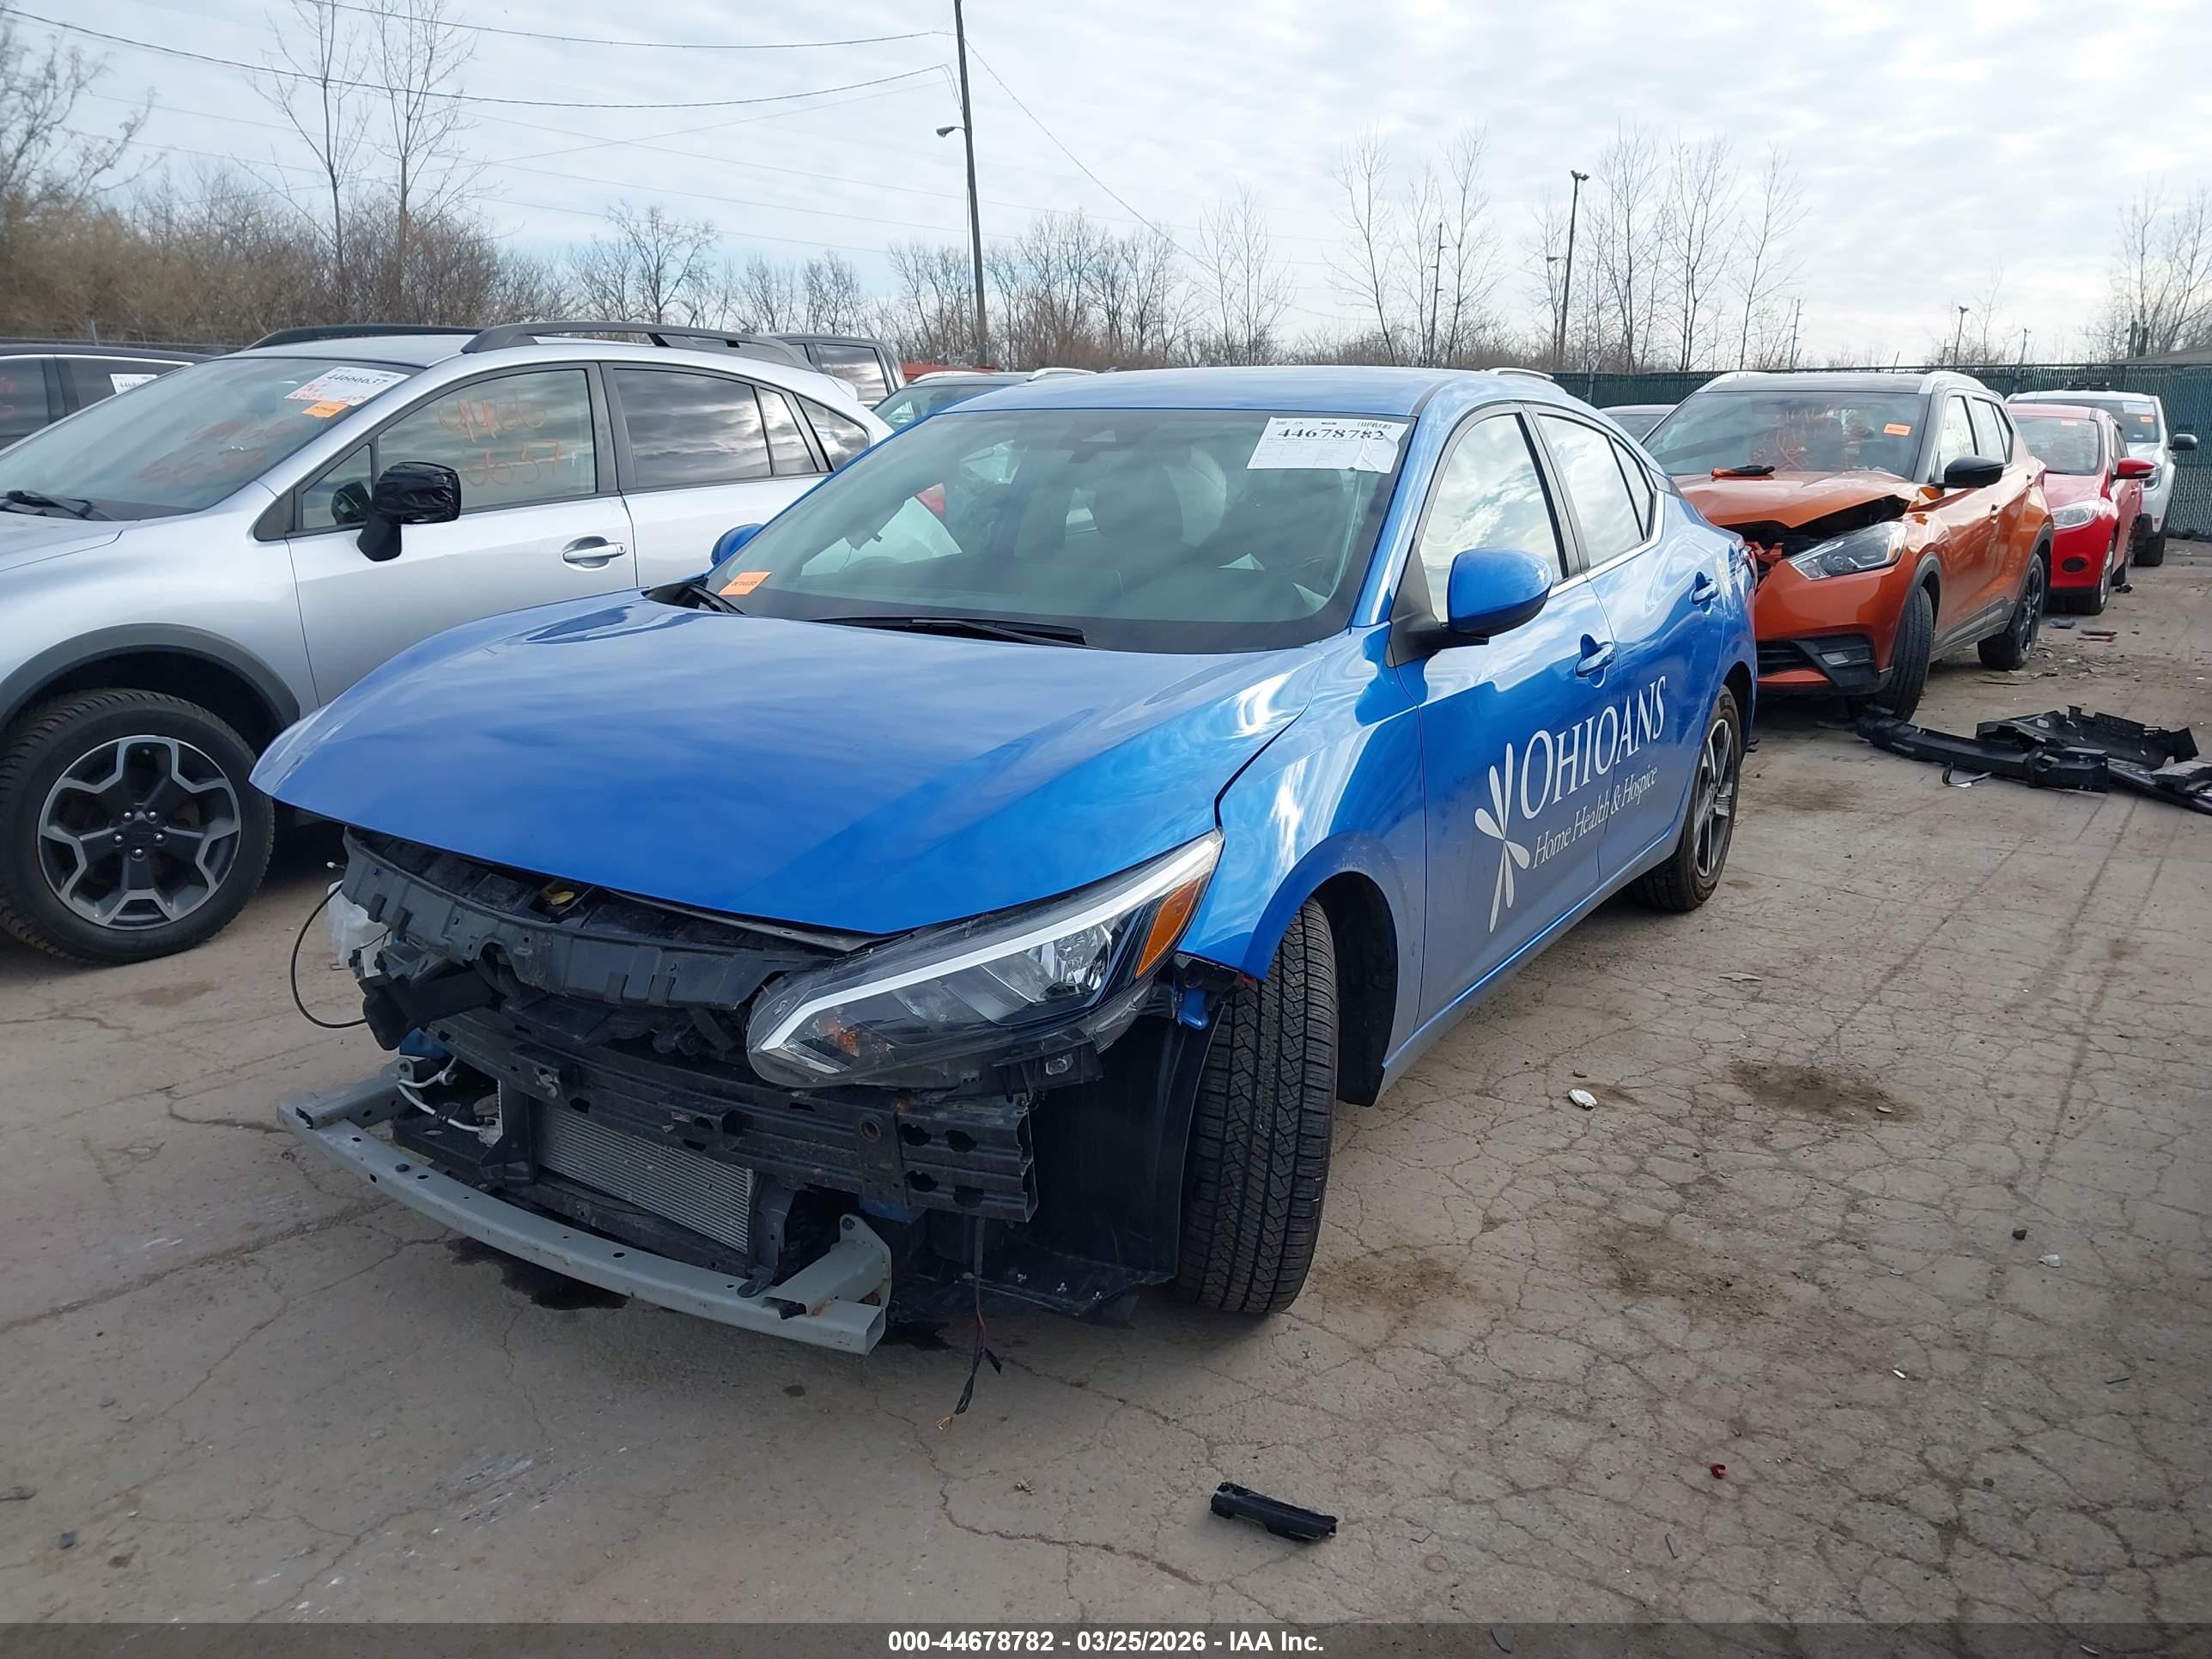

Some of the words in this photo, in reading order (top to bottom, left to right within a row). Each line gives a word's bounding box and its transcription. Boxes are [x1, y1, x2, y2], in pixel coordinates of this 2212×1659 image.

[1277, 428, 1384, 441] 44678782
[1520, 675, 1667, 820] OHIOANS
[1532, 826, 1571, 870] Home
[1571, 789, 1611, 842] Health
[1610, 784, 1621, 816] &
[1620, 763, 1658, 808] Hospice
